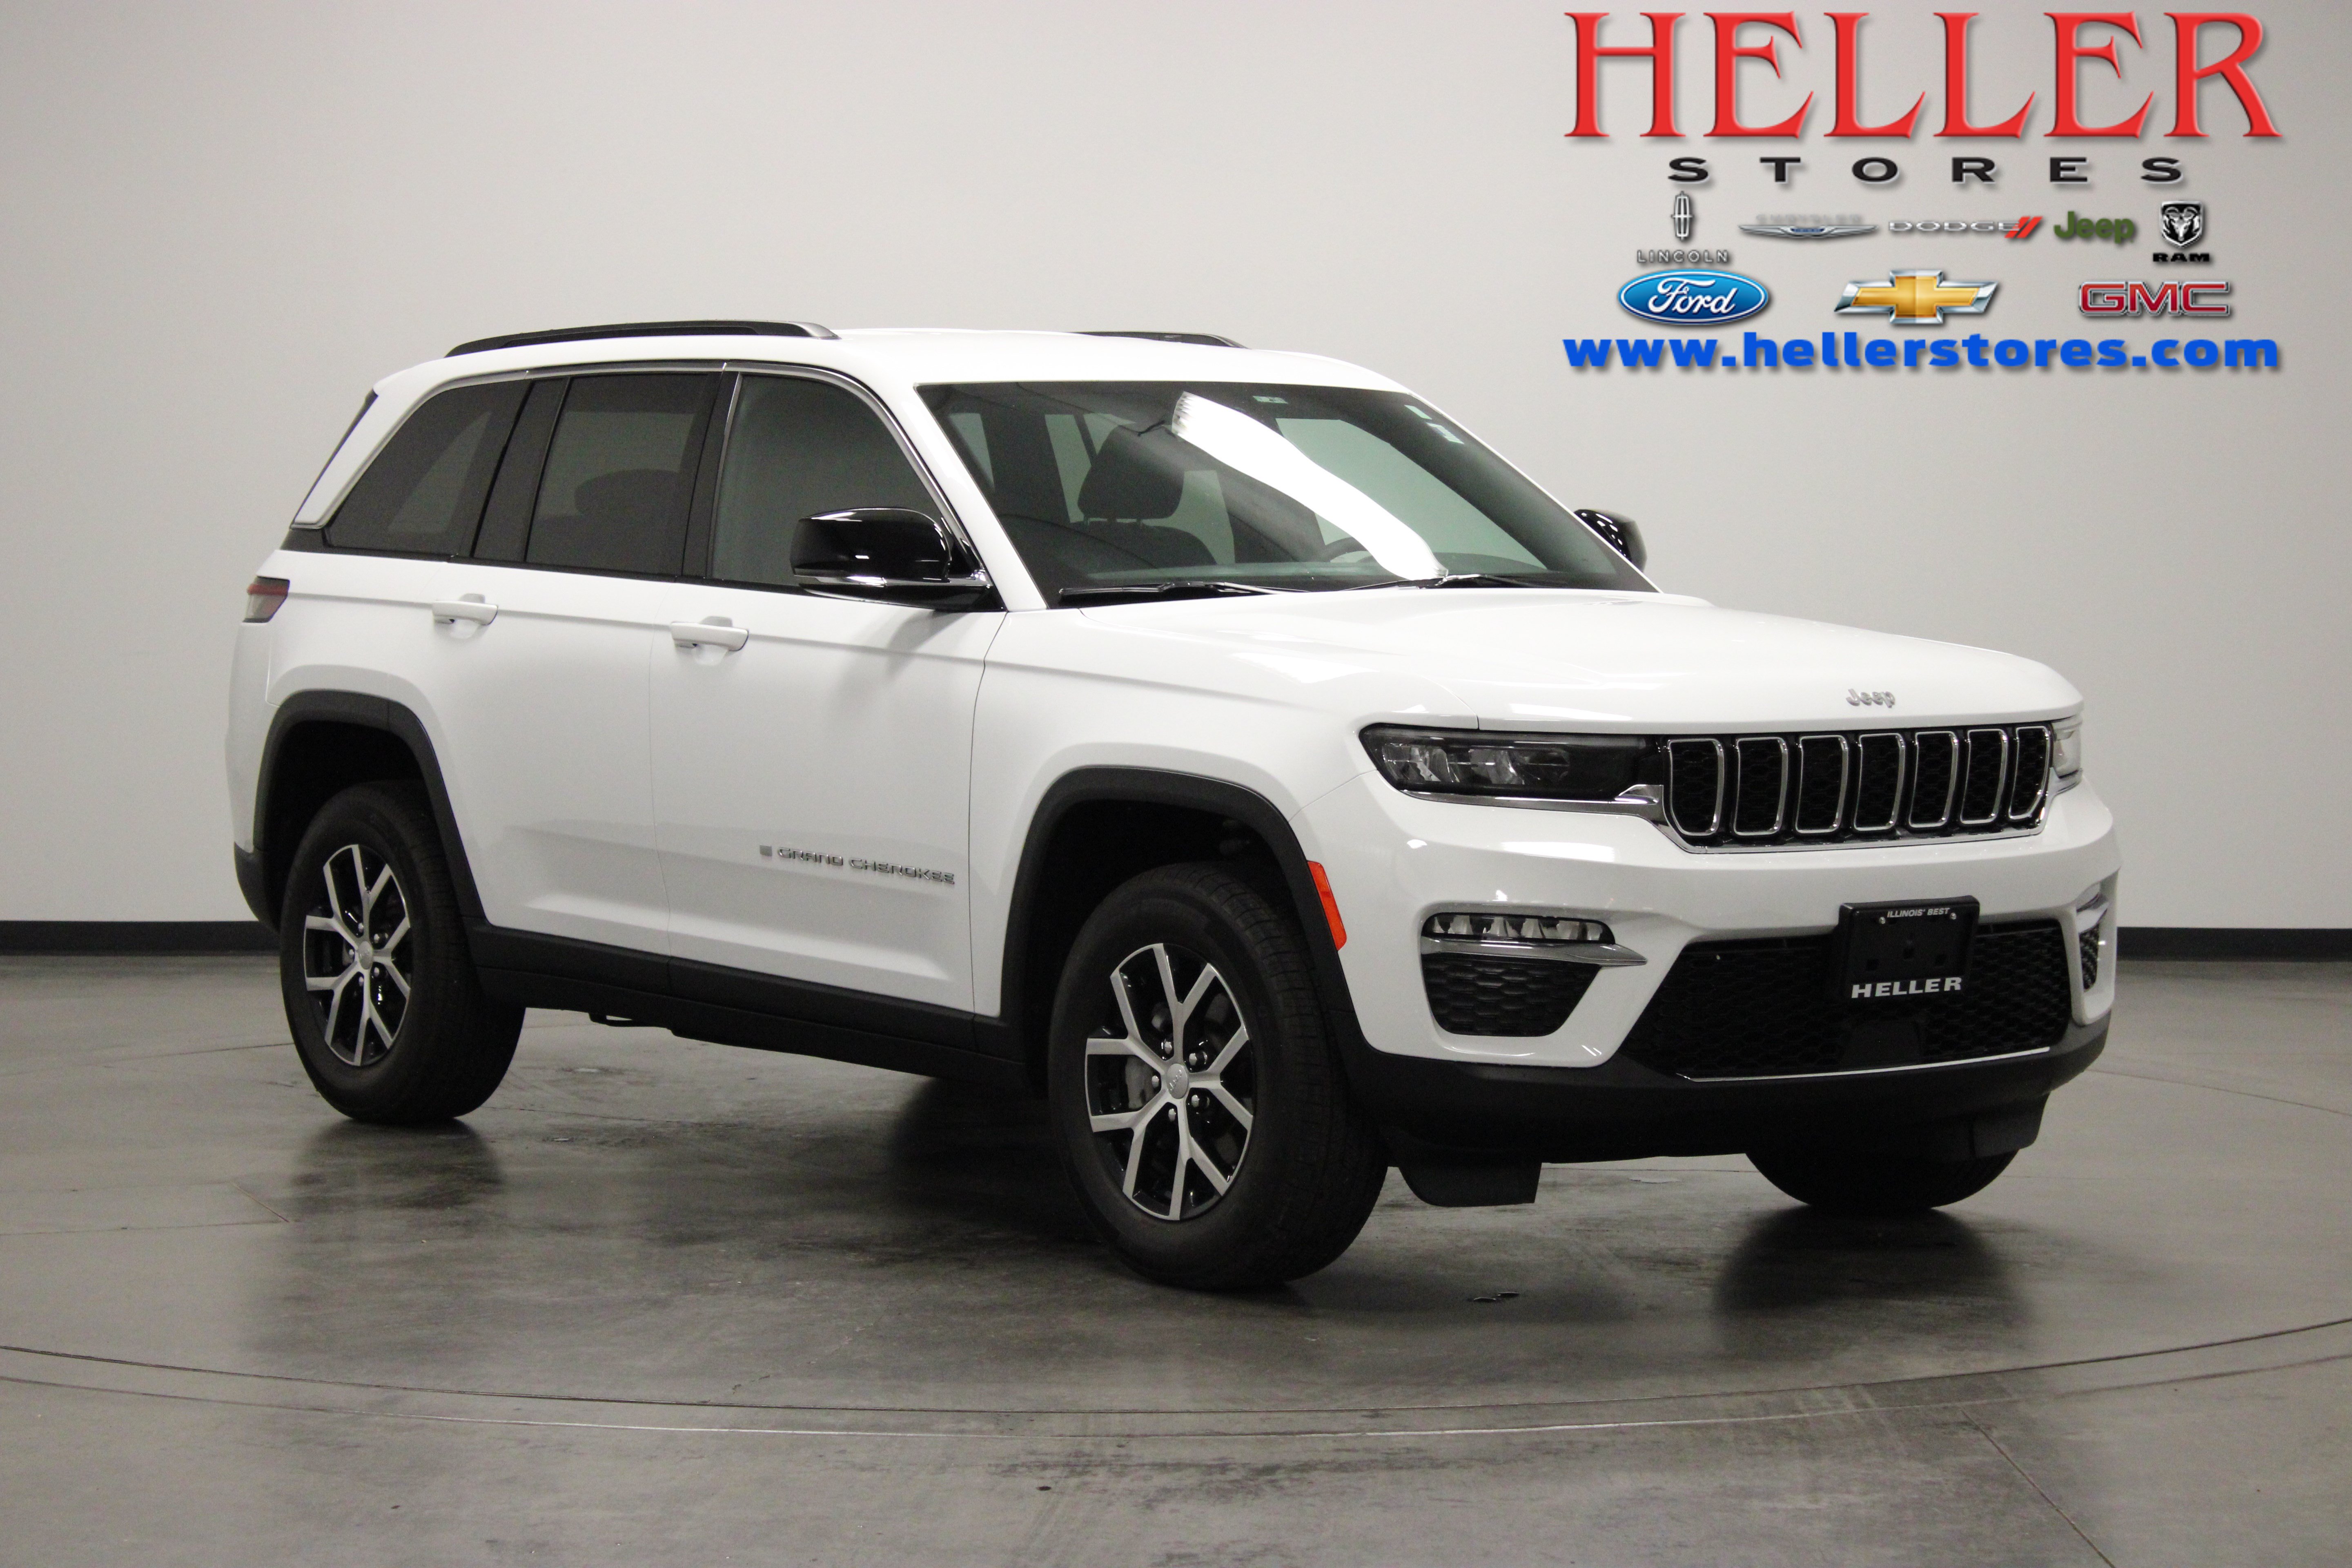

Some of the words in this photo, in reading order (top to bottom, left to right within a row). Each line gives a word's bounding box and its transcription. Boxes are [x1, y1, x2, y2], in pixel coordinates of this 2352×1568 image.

[1846, 688, 1895, 708] Jeep
[777, 847, 844, 866] GRAND
[849, 858, 955, 885] CHEROKEE
[1887, 909, 1926, 918] ILLINOIS'
[1851, 977, 1962, 998] HELLER
